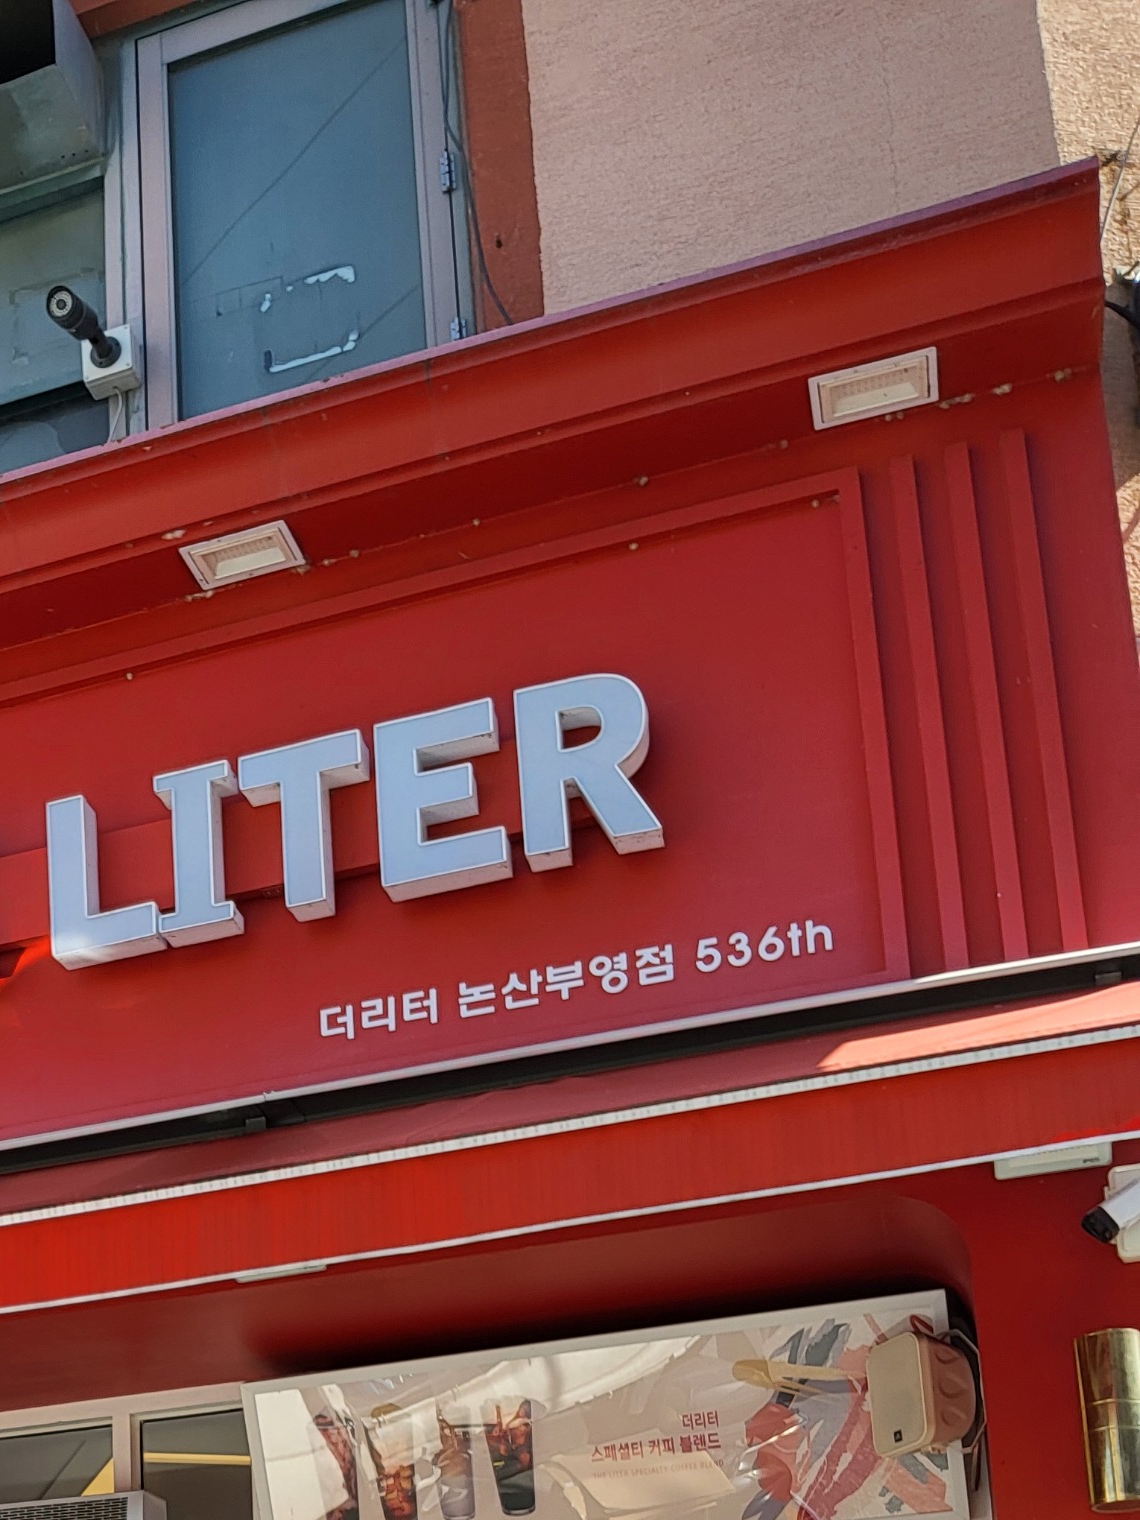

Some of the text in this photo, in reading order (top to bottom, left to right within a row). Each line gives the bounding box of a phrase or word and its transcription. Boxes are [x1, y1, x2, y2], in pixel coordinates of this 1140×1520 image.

[46, 672, 664, 970] LITER
[319, 920, 835, 1040] 더리터 논산부영점 536th
[591, 1432, 721, 1462] 스페셜티 커피 블렌드
[681, 1410, 719, 1430] 더리터
